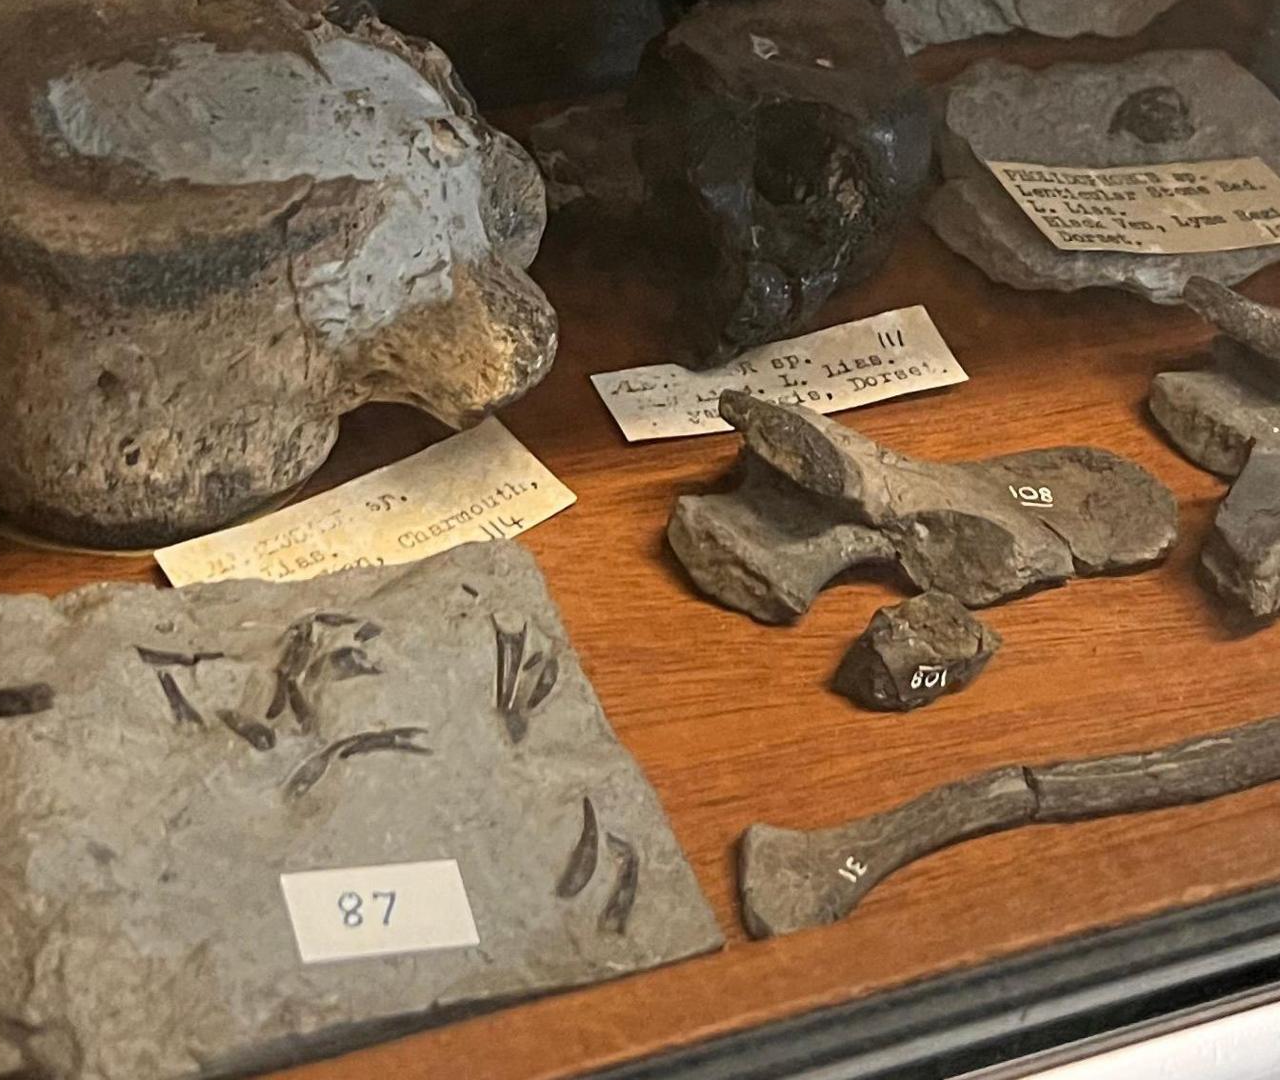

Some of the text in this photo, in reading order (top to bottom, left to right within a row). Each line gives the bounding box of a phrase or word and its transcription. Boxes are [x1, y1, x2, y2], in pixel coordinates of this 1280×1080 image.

[770, 354, 812, 370] sp.
[778, 372, 808, 388] L.
[1008, 484, 1053, 504] 108
[397, 480, 539, 549] Charmouth,
[480, 515, 525, 541] 114
[337, 890, 397, 927] 87
